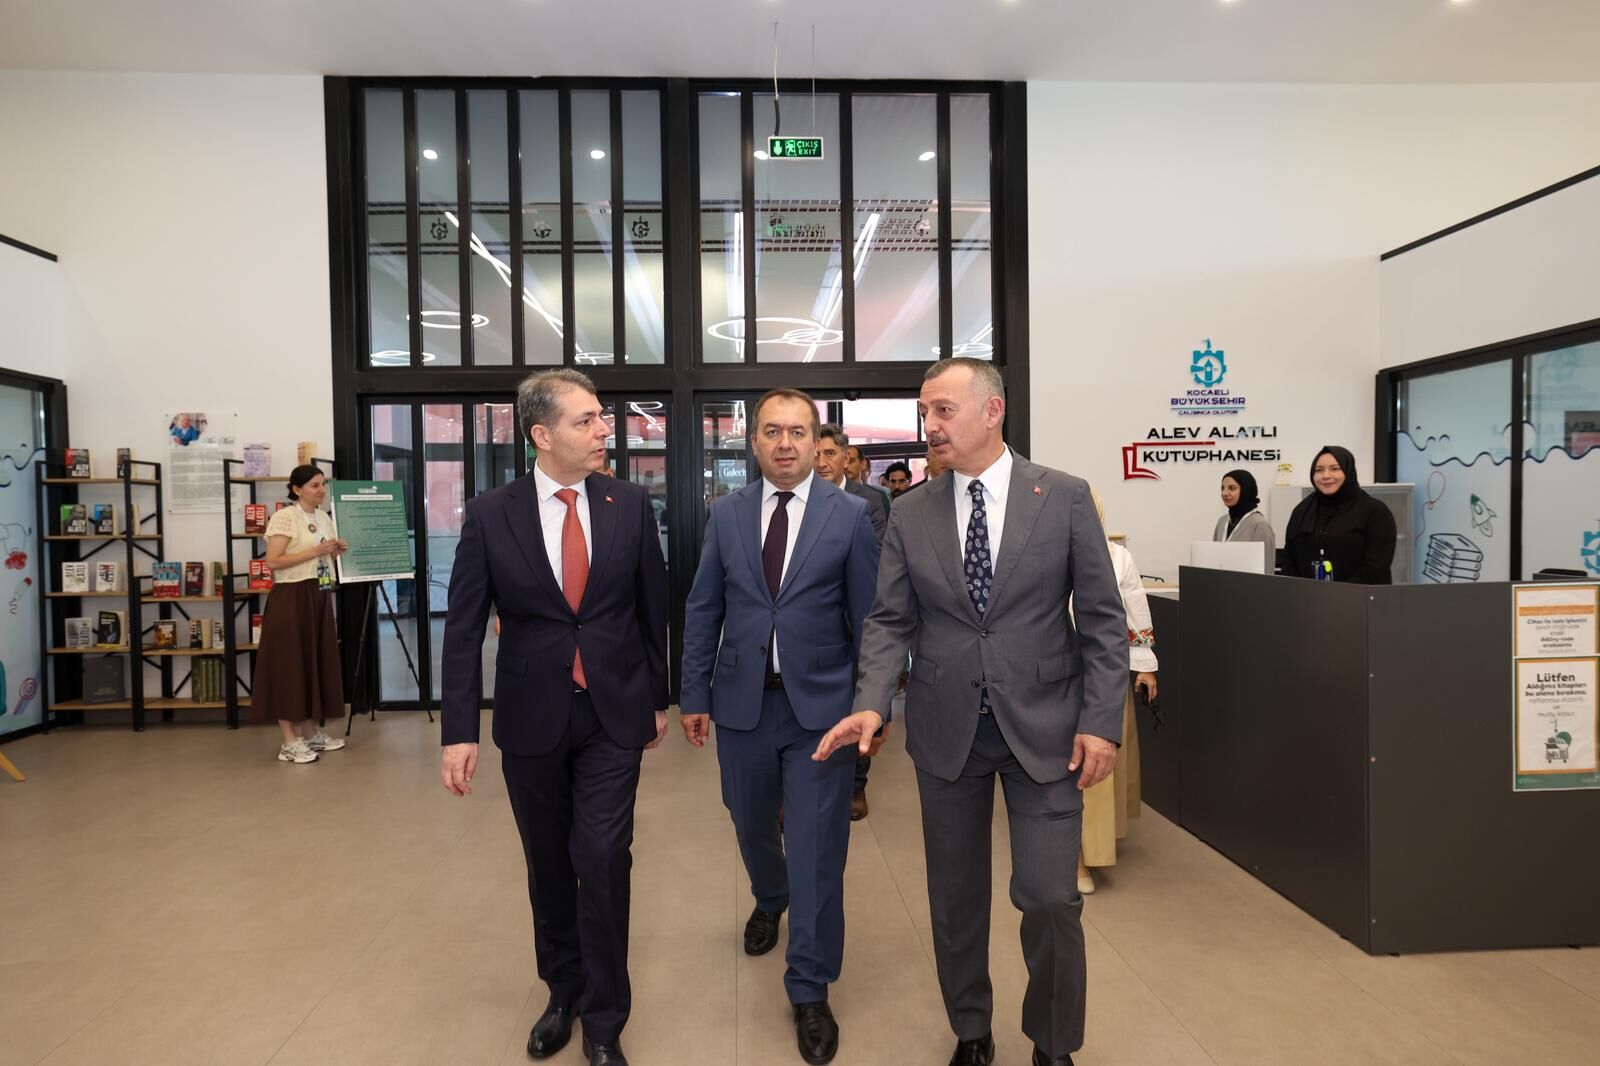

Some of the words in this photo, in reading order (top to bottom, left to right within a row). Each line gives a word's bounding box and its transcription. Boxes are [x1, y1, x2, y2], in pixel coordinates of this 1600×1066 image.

[1147, 427, 1201, 439] ALEV
[1208, 426, 1277, 438] ALATLI
[1536, 673, 1575, 682] Lütfen
